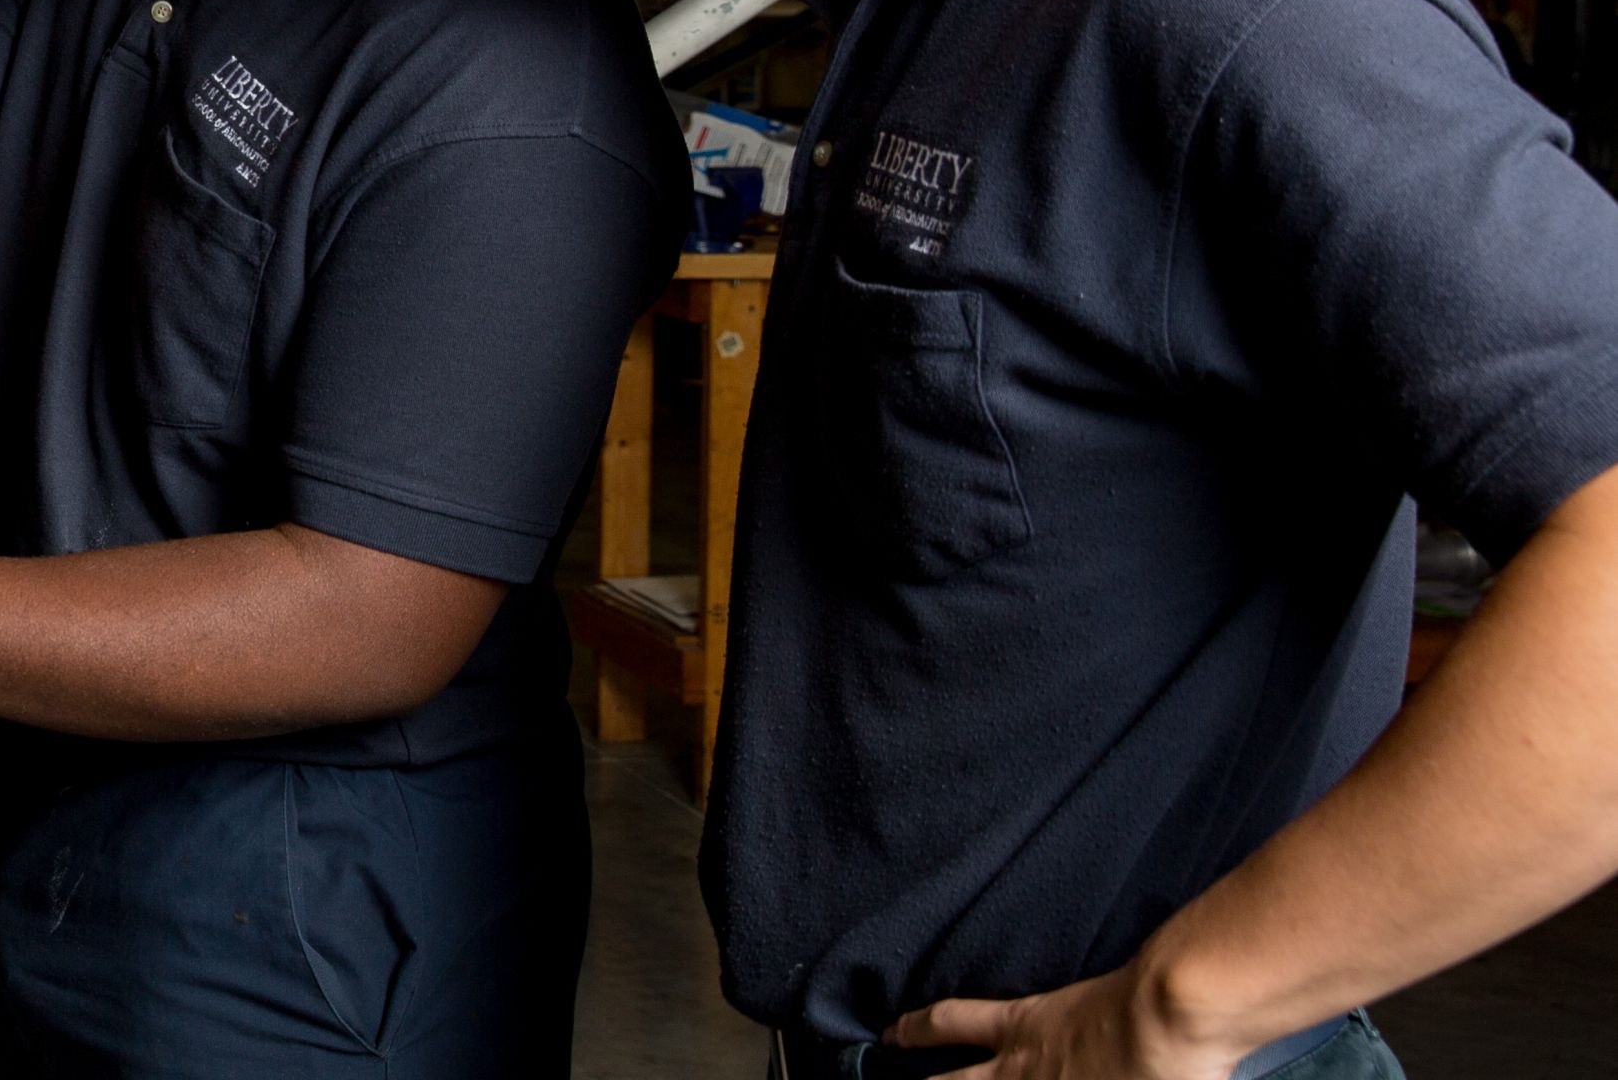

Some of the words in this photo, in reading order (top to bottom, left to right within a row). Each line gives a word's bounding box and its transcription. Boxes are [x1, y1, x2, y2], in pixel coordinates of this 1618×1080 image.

[192, 93, 217, 123] SCHOOL
[213, 118, 229, 132] of
[202, 79, 278, 155] UNIVERSITY
[211, 55, 299, 142] LIBERTY
[865, 171, 958, 214] UNIVERSITY
[870, 131, 973, 196] LIBERTY
